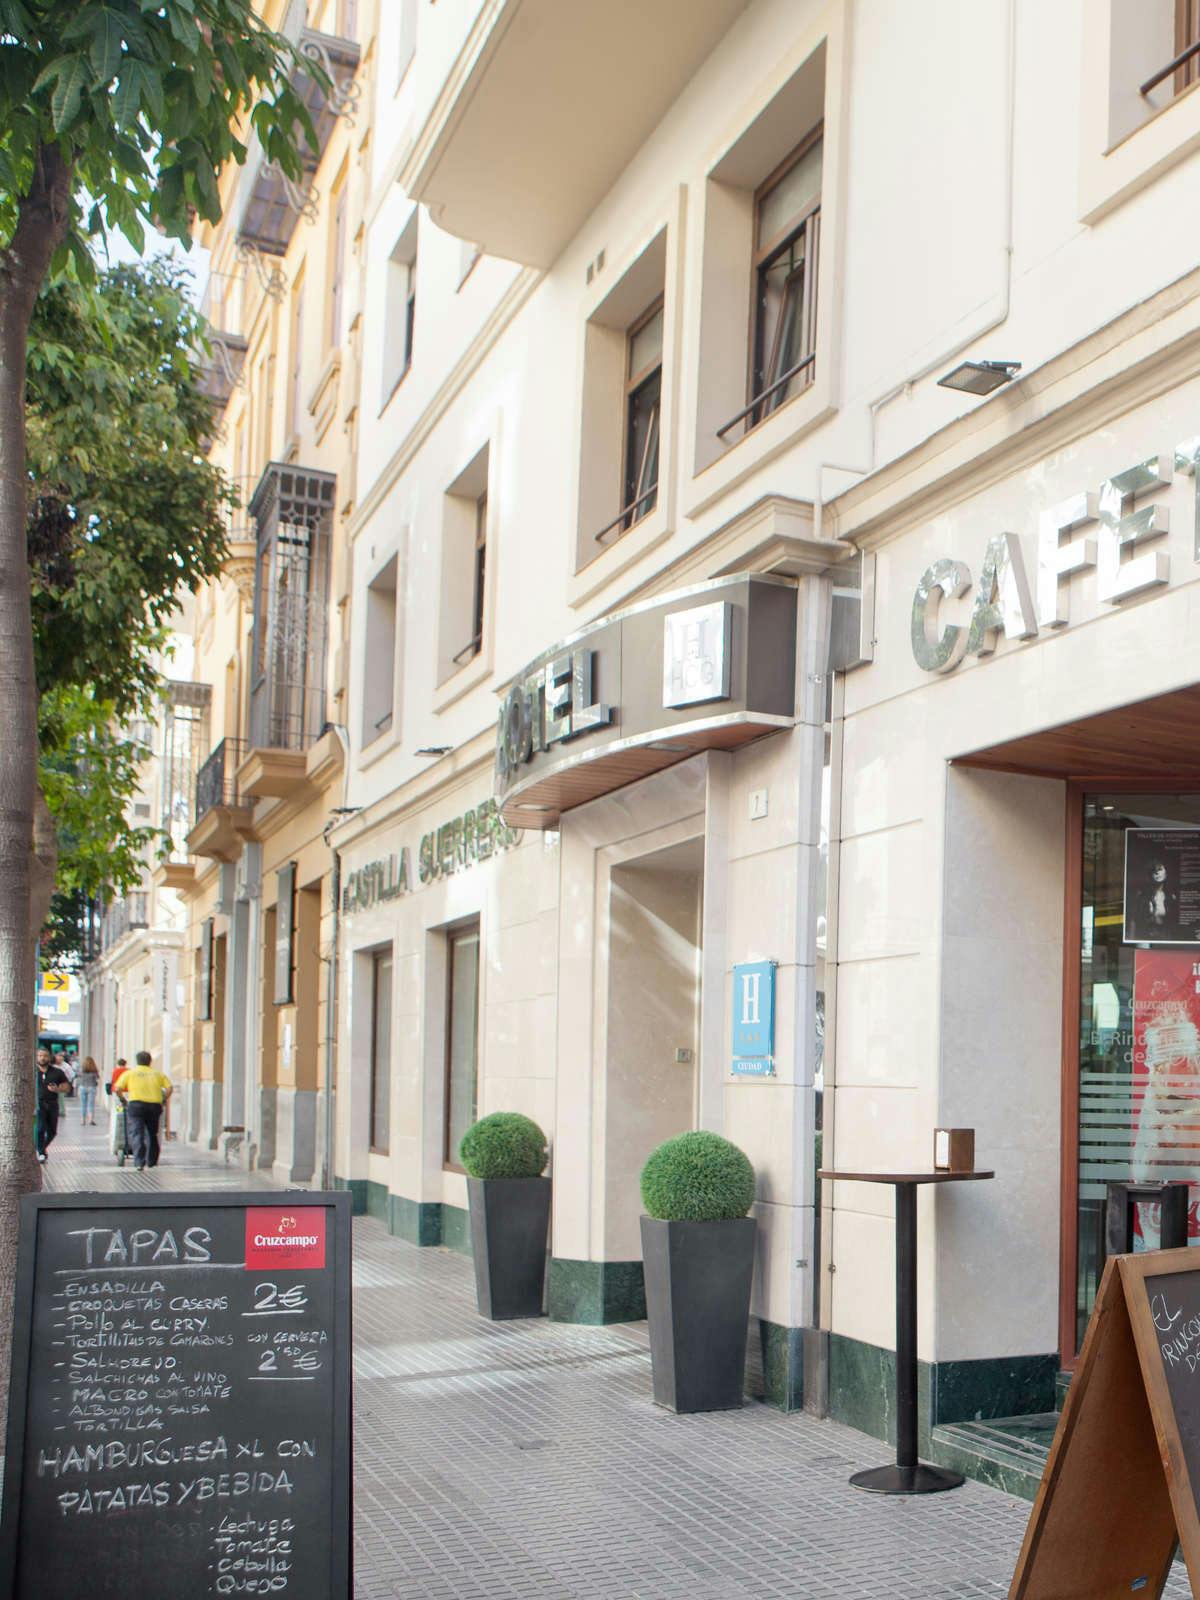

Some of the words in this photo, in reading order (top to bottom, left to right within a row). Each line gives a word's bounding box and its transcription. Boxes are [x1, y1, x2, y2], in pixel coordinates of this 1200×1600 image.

[741, 973, 761, 1025] H
[66, 1227, 212, 1264] TAPAS
[254, 1235, 318, 1247] Cruzcampo
[64, 1280, 166, 1297] ENSADILLA
[254, 1283, 308, 1309] 2€
[68, 1297, 163, 1312] CROQUETAS
[169, 1296, 229, 1311] CASERAS
[68, 1371, 162, 1384] SALCHICHAS
[193, 1371, 228, 1383] VINO
[37, 1436, 229, 1478] HAMBURGUESA
[276, 1439, 317, 1458] CON
[57, 1481, 171, 1516] PATATAS
[197, 1469, 294, 1500] BEBIDA
